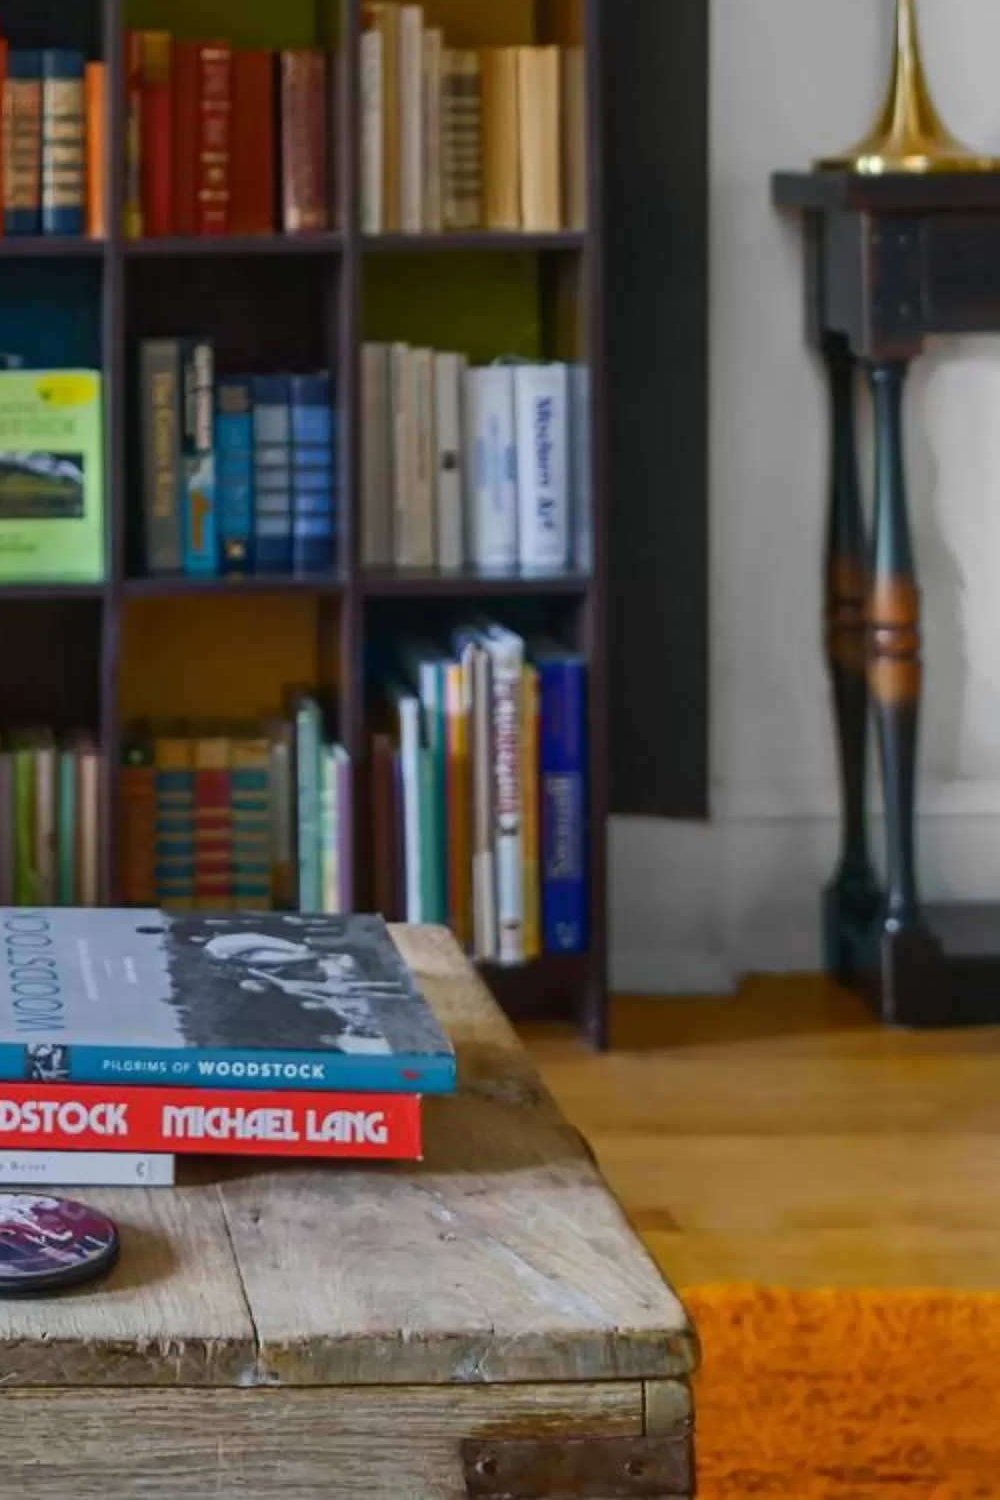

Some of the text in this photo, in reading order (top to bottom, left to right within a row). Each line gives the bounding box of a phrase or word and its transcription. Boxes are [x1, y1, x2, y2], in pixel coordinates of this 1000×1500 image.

[4, 911, 67, 1033] WOODSTOCK
[102, 1058, 326, 1081] PILGRIMS OF WOODSTOCK
[161, 1104, 300, 1142] MICHAEL
[306, 1109, 389, 1144] LANG
